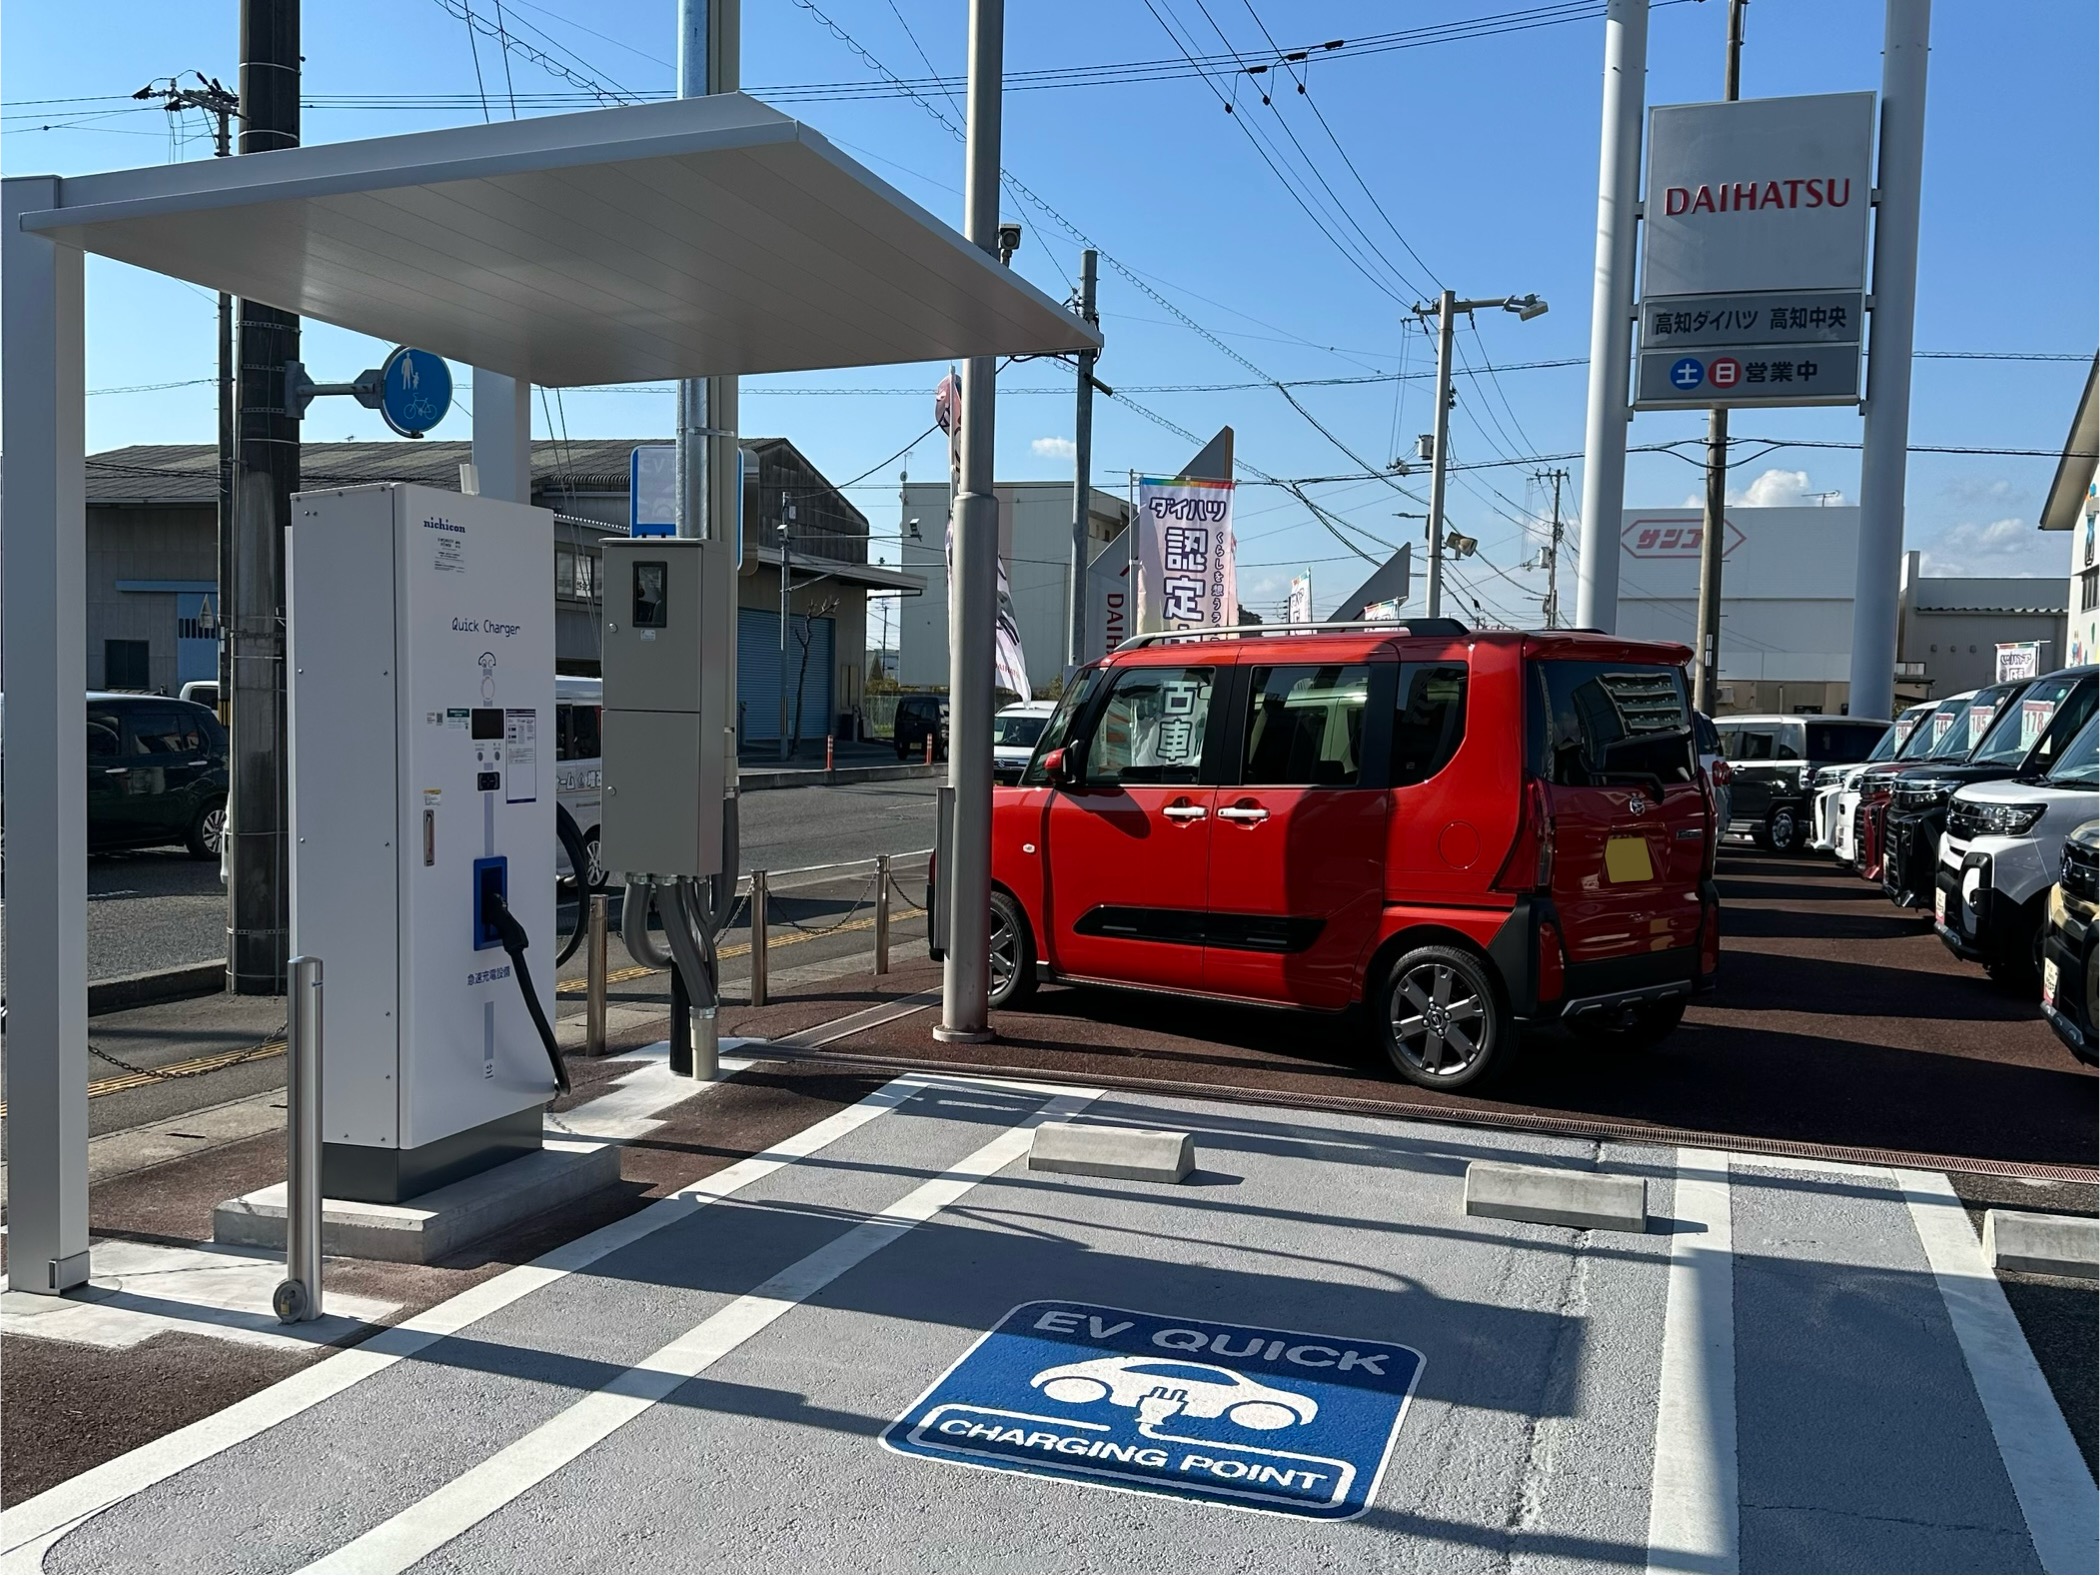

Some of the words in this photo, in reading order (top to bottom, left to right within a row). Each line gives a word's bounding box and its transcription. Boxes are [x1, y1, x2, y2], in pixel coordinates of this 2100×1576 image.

[1664, 178, 1850, 216] DAIHATSU
[1655, 310, 1758, 335] 高知ダイハツ
[1770, 306, 1847, 330] 高知中央
[1676, 363, 1699, 384] 土
[1715, 363, 1735, 383] 日
[1745, 360, 1818, 383] 営業中
[423, 517, 466, 533] nichicon
[1149, 497, 1227, 522] ダイハツ
[1211, 531, 1225, 641] くらしを想うラ
[452, 617, 479, 632] Quick
[483, 619, 521, 637] Charger
[1106, 593, 1124, 655] DAIH
[1033, 1310, 1136, 1339] EV
[1151, 1328, 1390, 1375] QUICK
[938, 1418, 1172, 1468] CHARGING
[1180, 1453, 1329, 1490] POINT
